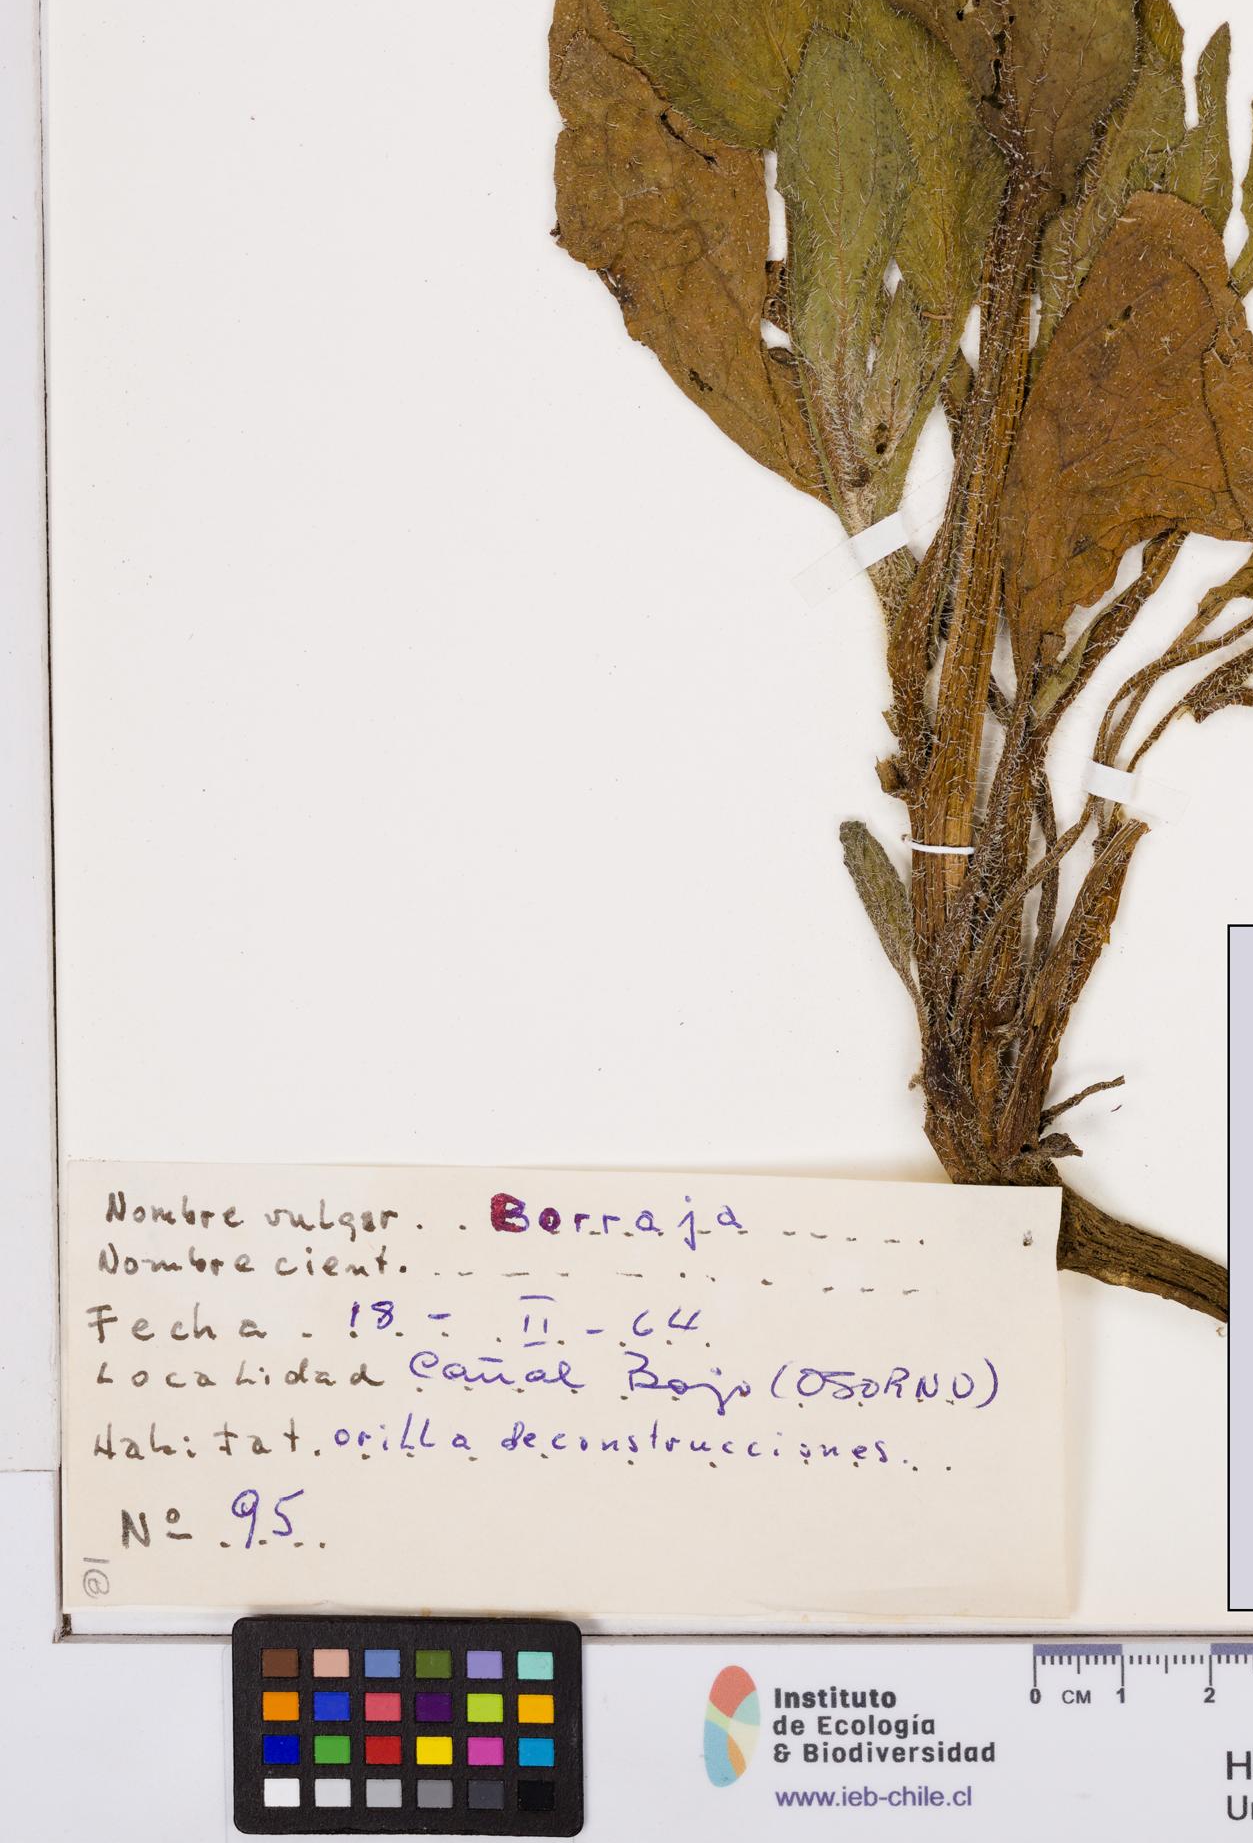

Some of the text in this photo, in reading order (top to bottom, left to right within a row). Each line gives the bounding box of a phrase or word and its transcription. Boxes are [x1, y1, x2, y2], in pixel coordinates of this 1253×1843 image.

[105, 1190, 245, 1229] Nombre
[488, 1190, 744, 1252] Borraja
[98, 1242, 255, 1277] Nombre
[86, 1302, 268, 1344] Fecha
[96, 1357, 385, 1389] Localidad
[230, 1488, 306, 1550] 95
[774, 1685, 897, 1709] Instituto
[1029, 1687, 1042, 1705] 0
[1061, 1689, 1092, 1705] CM
[1116, 1687, 1126, 1704] 1
[1203, 1686, 1216, 1704] 2
[772, 1714, 936, 1738] de Ecología
[773, 1740, 996, 1764] & Biodiversidad
[774, 1785, 972, 1807] www.ieb-chile.cl
